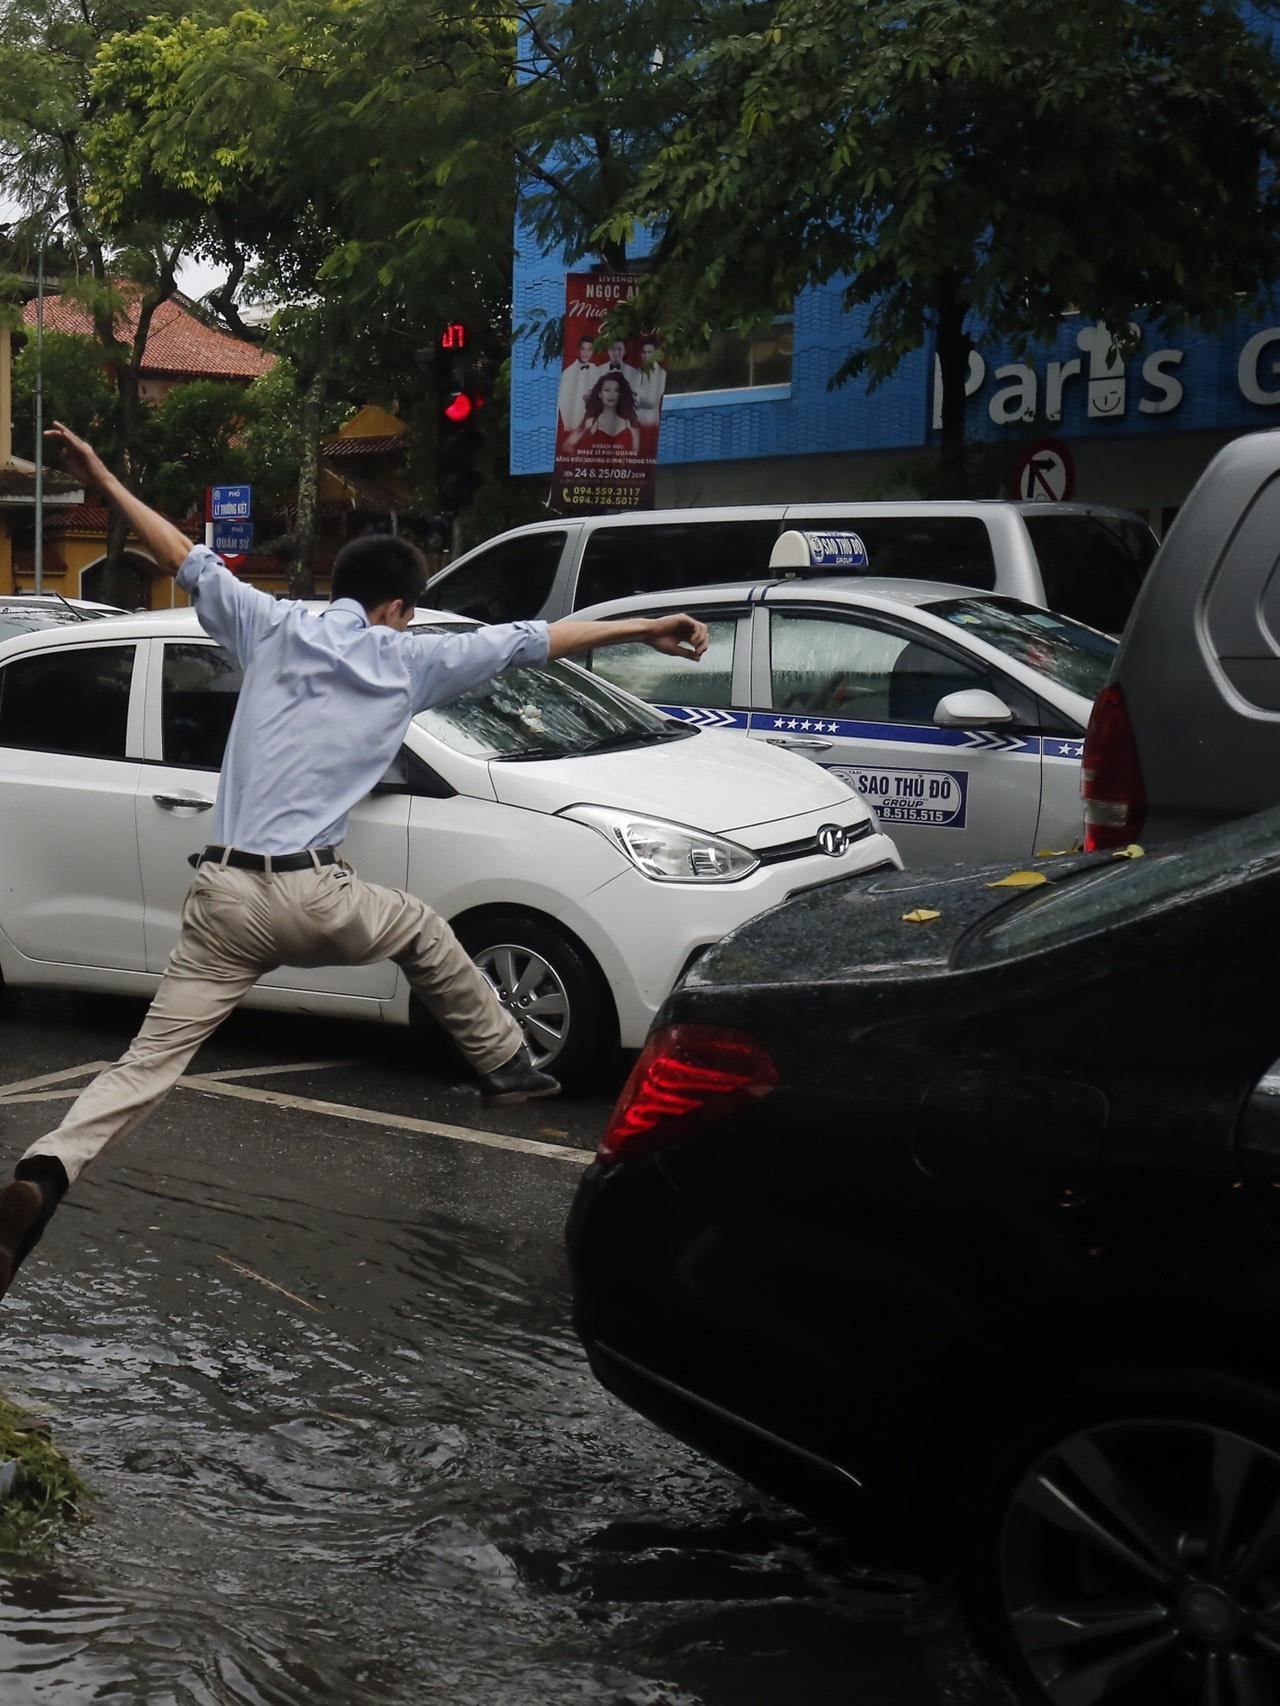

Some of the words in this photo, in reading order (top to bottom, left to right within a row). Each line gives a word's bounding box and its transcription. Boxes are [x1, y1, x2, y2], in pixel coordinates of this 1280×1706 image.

[586, 284, 620, 301] NGỌC
[575, 468, 587, 477] 24
[589, 468, 597, 478] &
[573, 486, 640, 496] 094.559.3117
[572, 496, 640, 505] 094.726.5017
[821, 538, 839, 555] SAO
[858, 775, 889, 795] SAO
[894, 774, 924, 797] THỦ
[929, 777, 951, 799] ĐÔ
[882, 799, 924, 808] GROUP
[883, 808, 943, 821] 8.515.515
